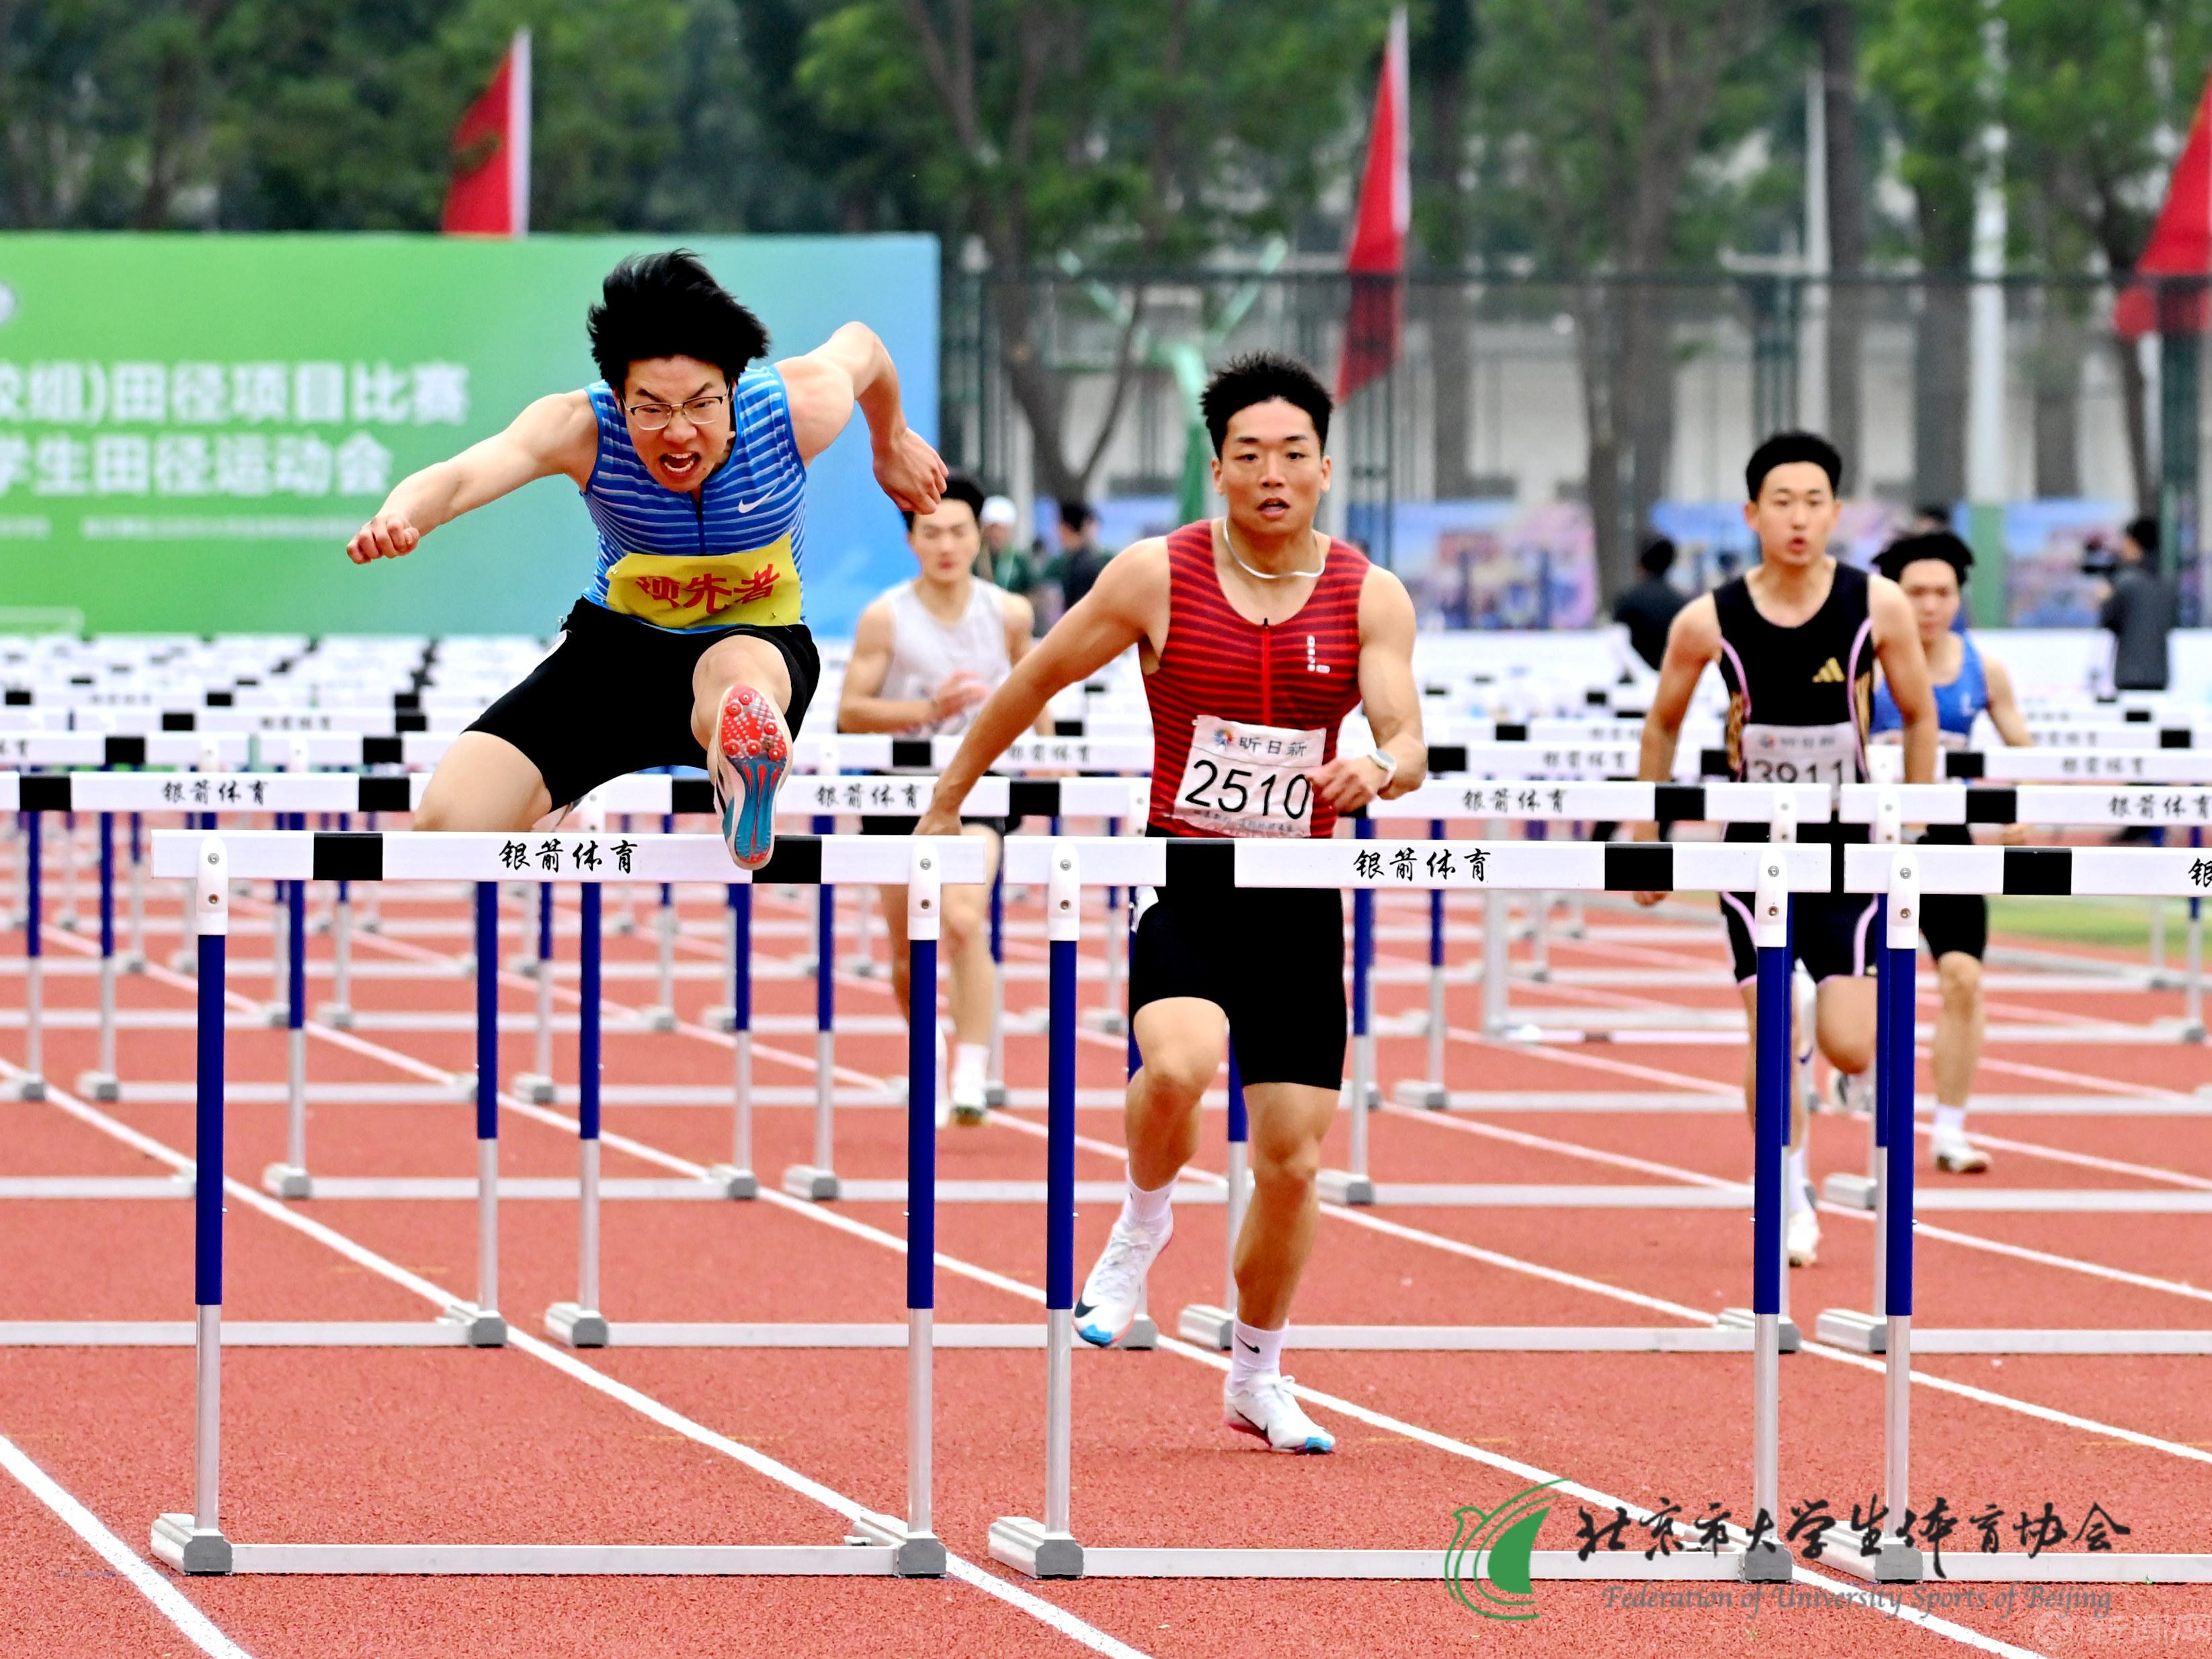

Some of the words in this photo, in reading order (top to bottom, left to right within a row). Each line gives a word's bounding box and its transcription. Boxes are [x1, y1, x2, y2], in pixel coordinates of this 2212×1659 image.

[163, 780, 268, 805] 银箭体育
[815, 782, 919, 809] 银箭体育
[1185, 760, 1311, 819] 2510
[1463, 788, 1567, 813] 银箭体育
[499, 839, 639, 874] 银箭体育
[1353, 848, 1491, 882] 银箭体育
